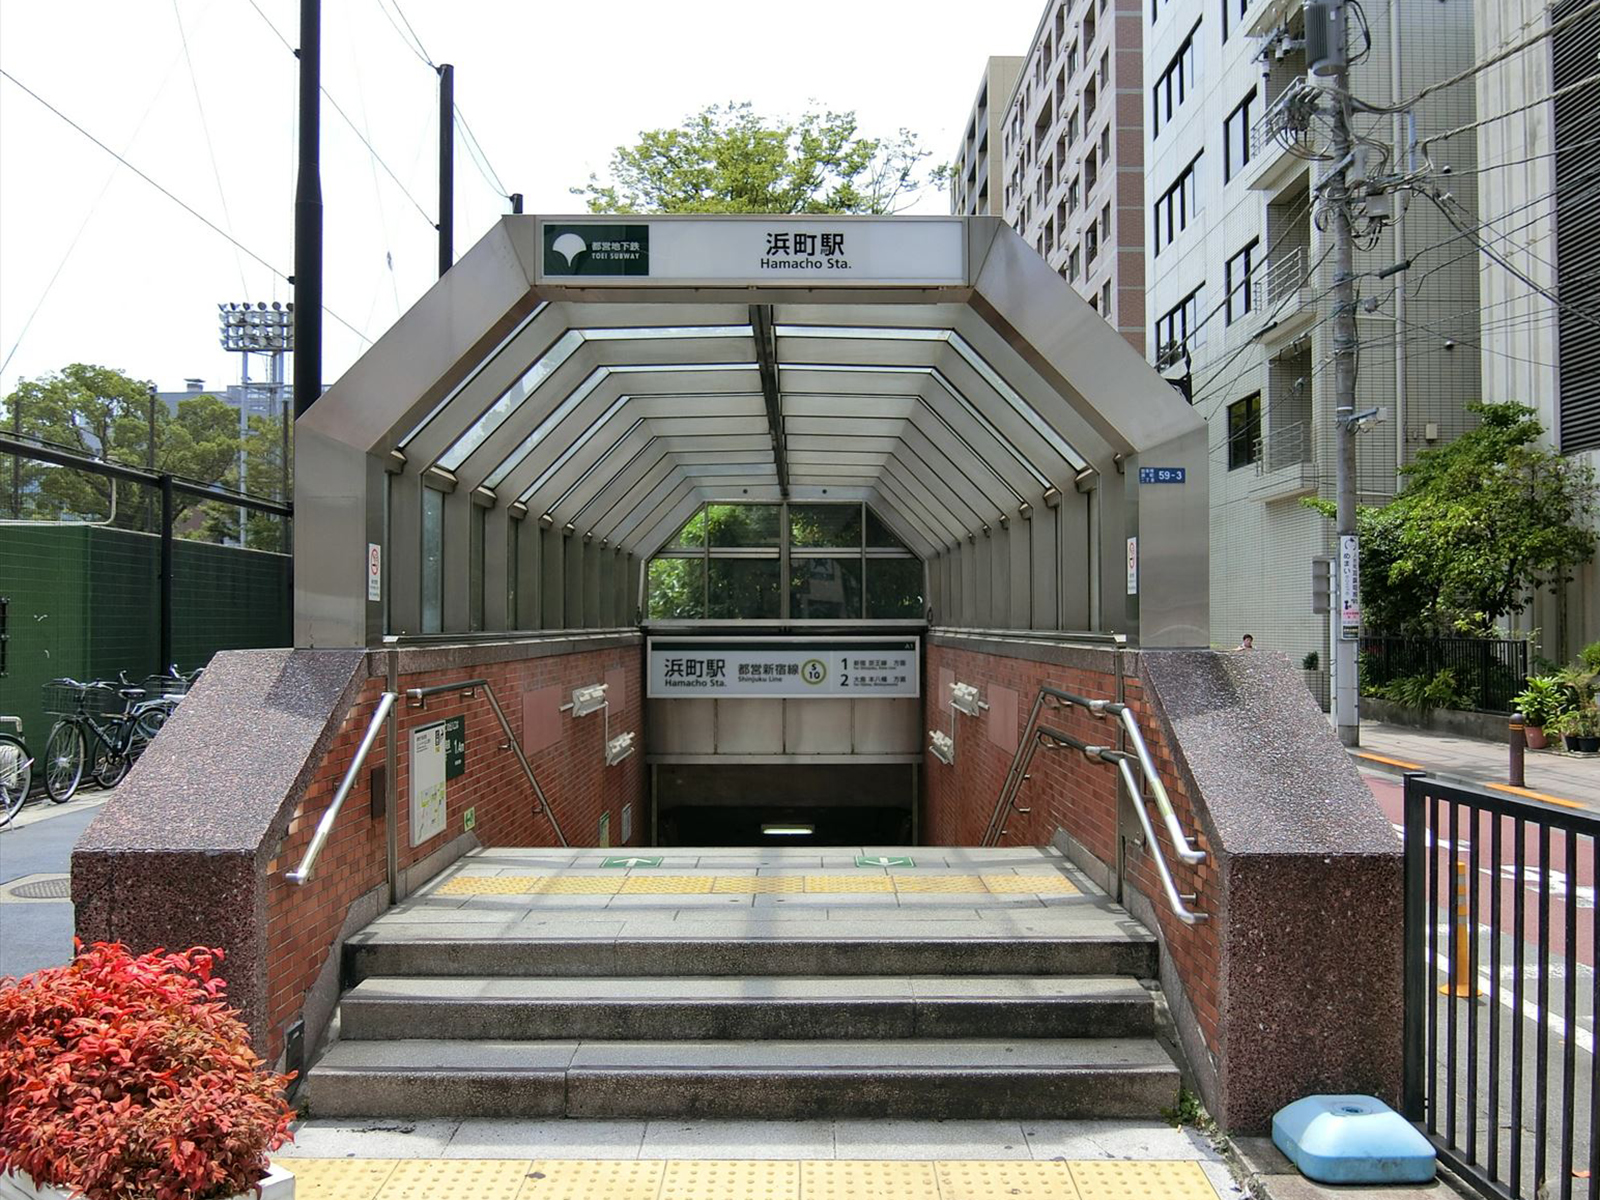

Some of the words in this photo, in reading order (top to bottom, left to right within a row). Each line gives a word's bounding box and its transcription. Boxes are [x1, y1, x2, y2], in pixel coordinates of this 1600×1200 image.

[591, 241, 640, 251] 都営地下鉄
[766, 232, 844, 256] 浜町駅
[760, 257, 823, 269] Hamacho
[827, 258, 852, 269] Sta.
[1158, 470, 1183, 480] 59-3
[664, 658, 726, 678] 浜町駅
[738, 663, 799, 676] 都営新宿線
[811, 663, 817, 671] S
[841, 657, 848, 670] 1
[809, 671, 821, 680] 10
[840, 673, 849, 687] 2
[664, 679, 708, 687] Hamacho
[709, 679, 728, 687] Sta.
